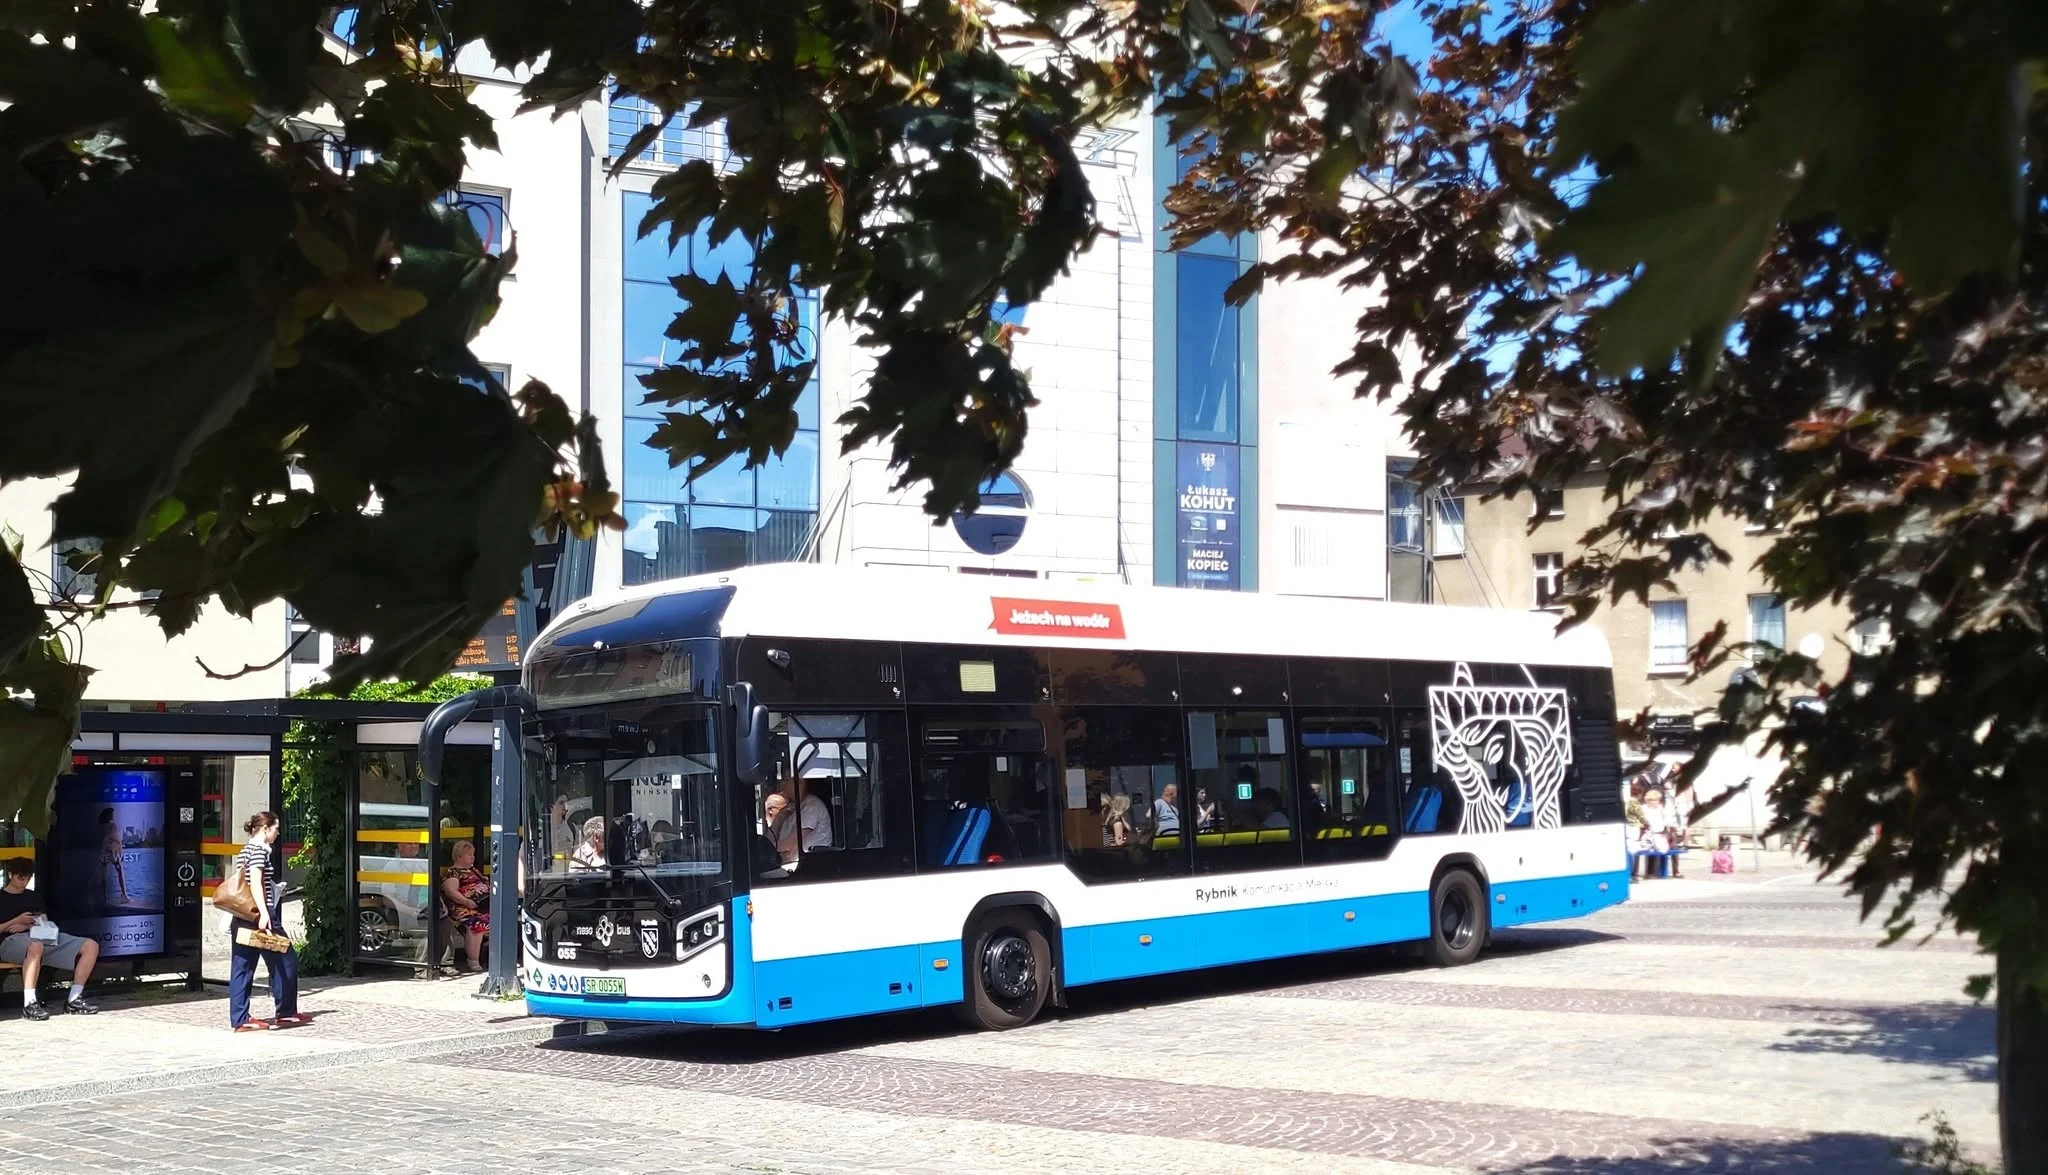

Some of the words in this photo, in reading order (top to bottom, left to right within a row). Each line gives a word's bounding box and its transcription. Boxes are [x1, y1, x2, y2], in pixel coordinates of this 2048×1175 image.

[1187, 484, 1228, 497] Łukasz
[1180, 494, 1235, 511] KOHUT
[1192, 550, 1224, 560] MACIEJ
[1187, 559, 1229, 572] KOPIEC
[1055, 614, 1072, 627] na
[112, 852, 140, 863] WEST
[1196, 885, 1238, 903] Rybnik
[1242, 882, 1302, 897] Komunikaca
[1305, 878, 1339, 889] Mieska
[616, 924, 631, 935] bus
[557, 947, 576, 960] 055
[586, 979, 597, 992] SR
